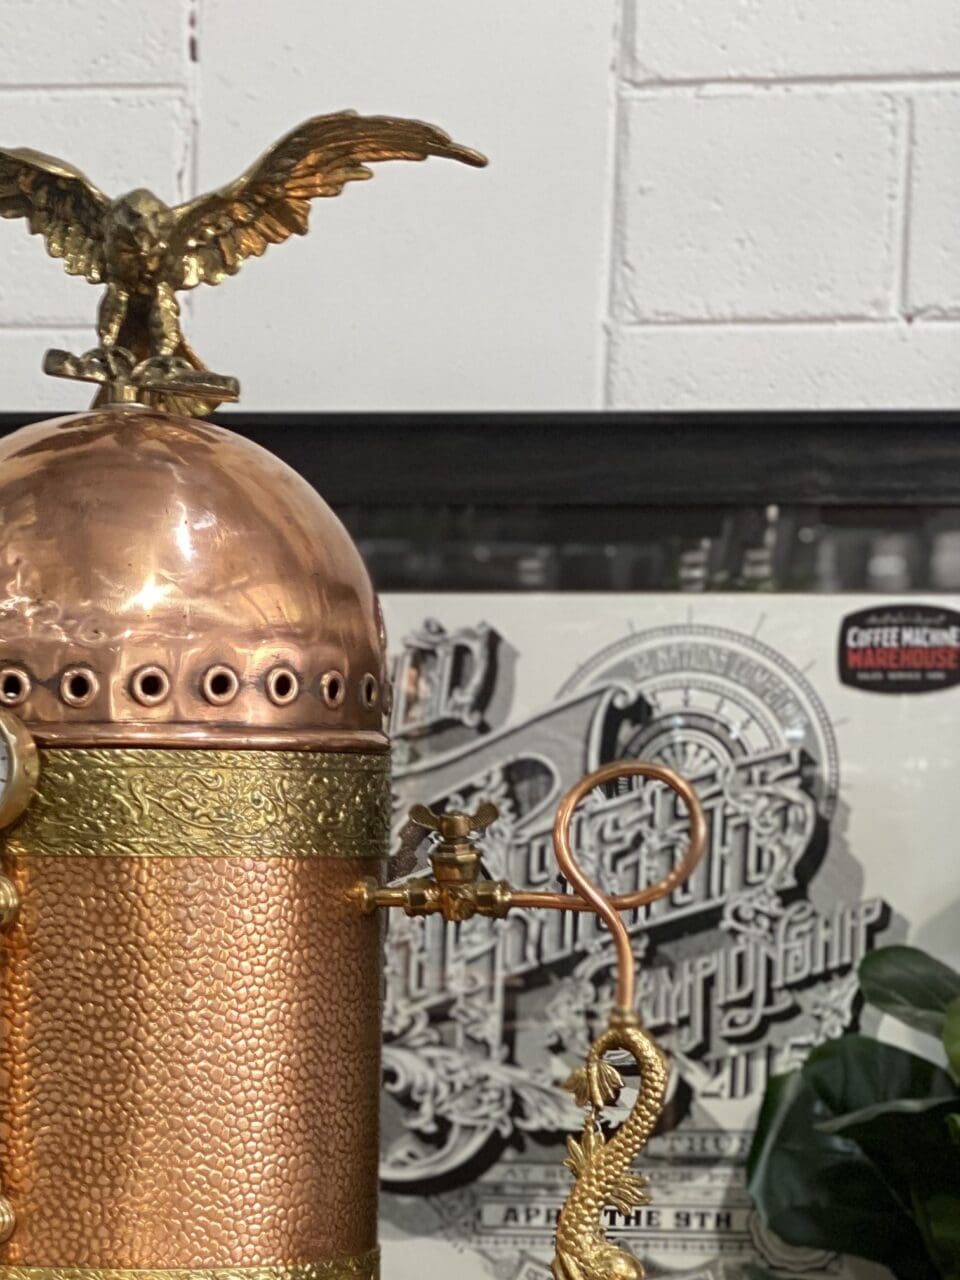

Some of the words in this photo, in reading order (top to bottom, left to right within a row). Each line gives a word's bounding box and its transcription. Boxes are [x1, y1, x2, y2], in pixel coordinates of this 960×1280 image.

[847, 626, 899, 648] COFFEE
[847, 647, 958, 669] WAREHOUSE
[604, 1209, 661, 1226] THE
[674, 1211, 732, 1228] 9TH
